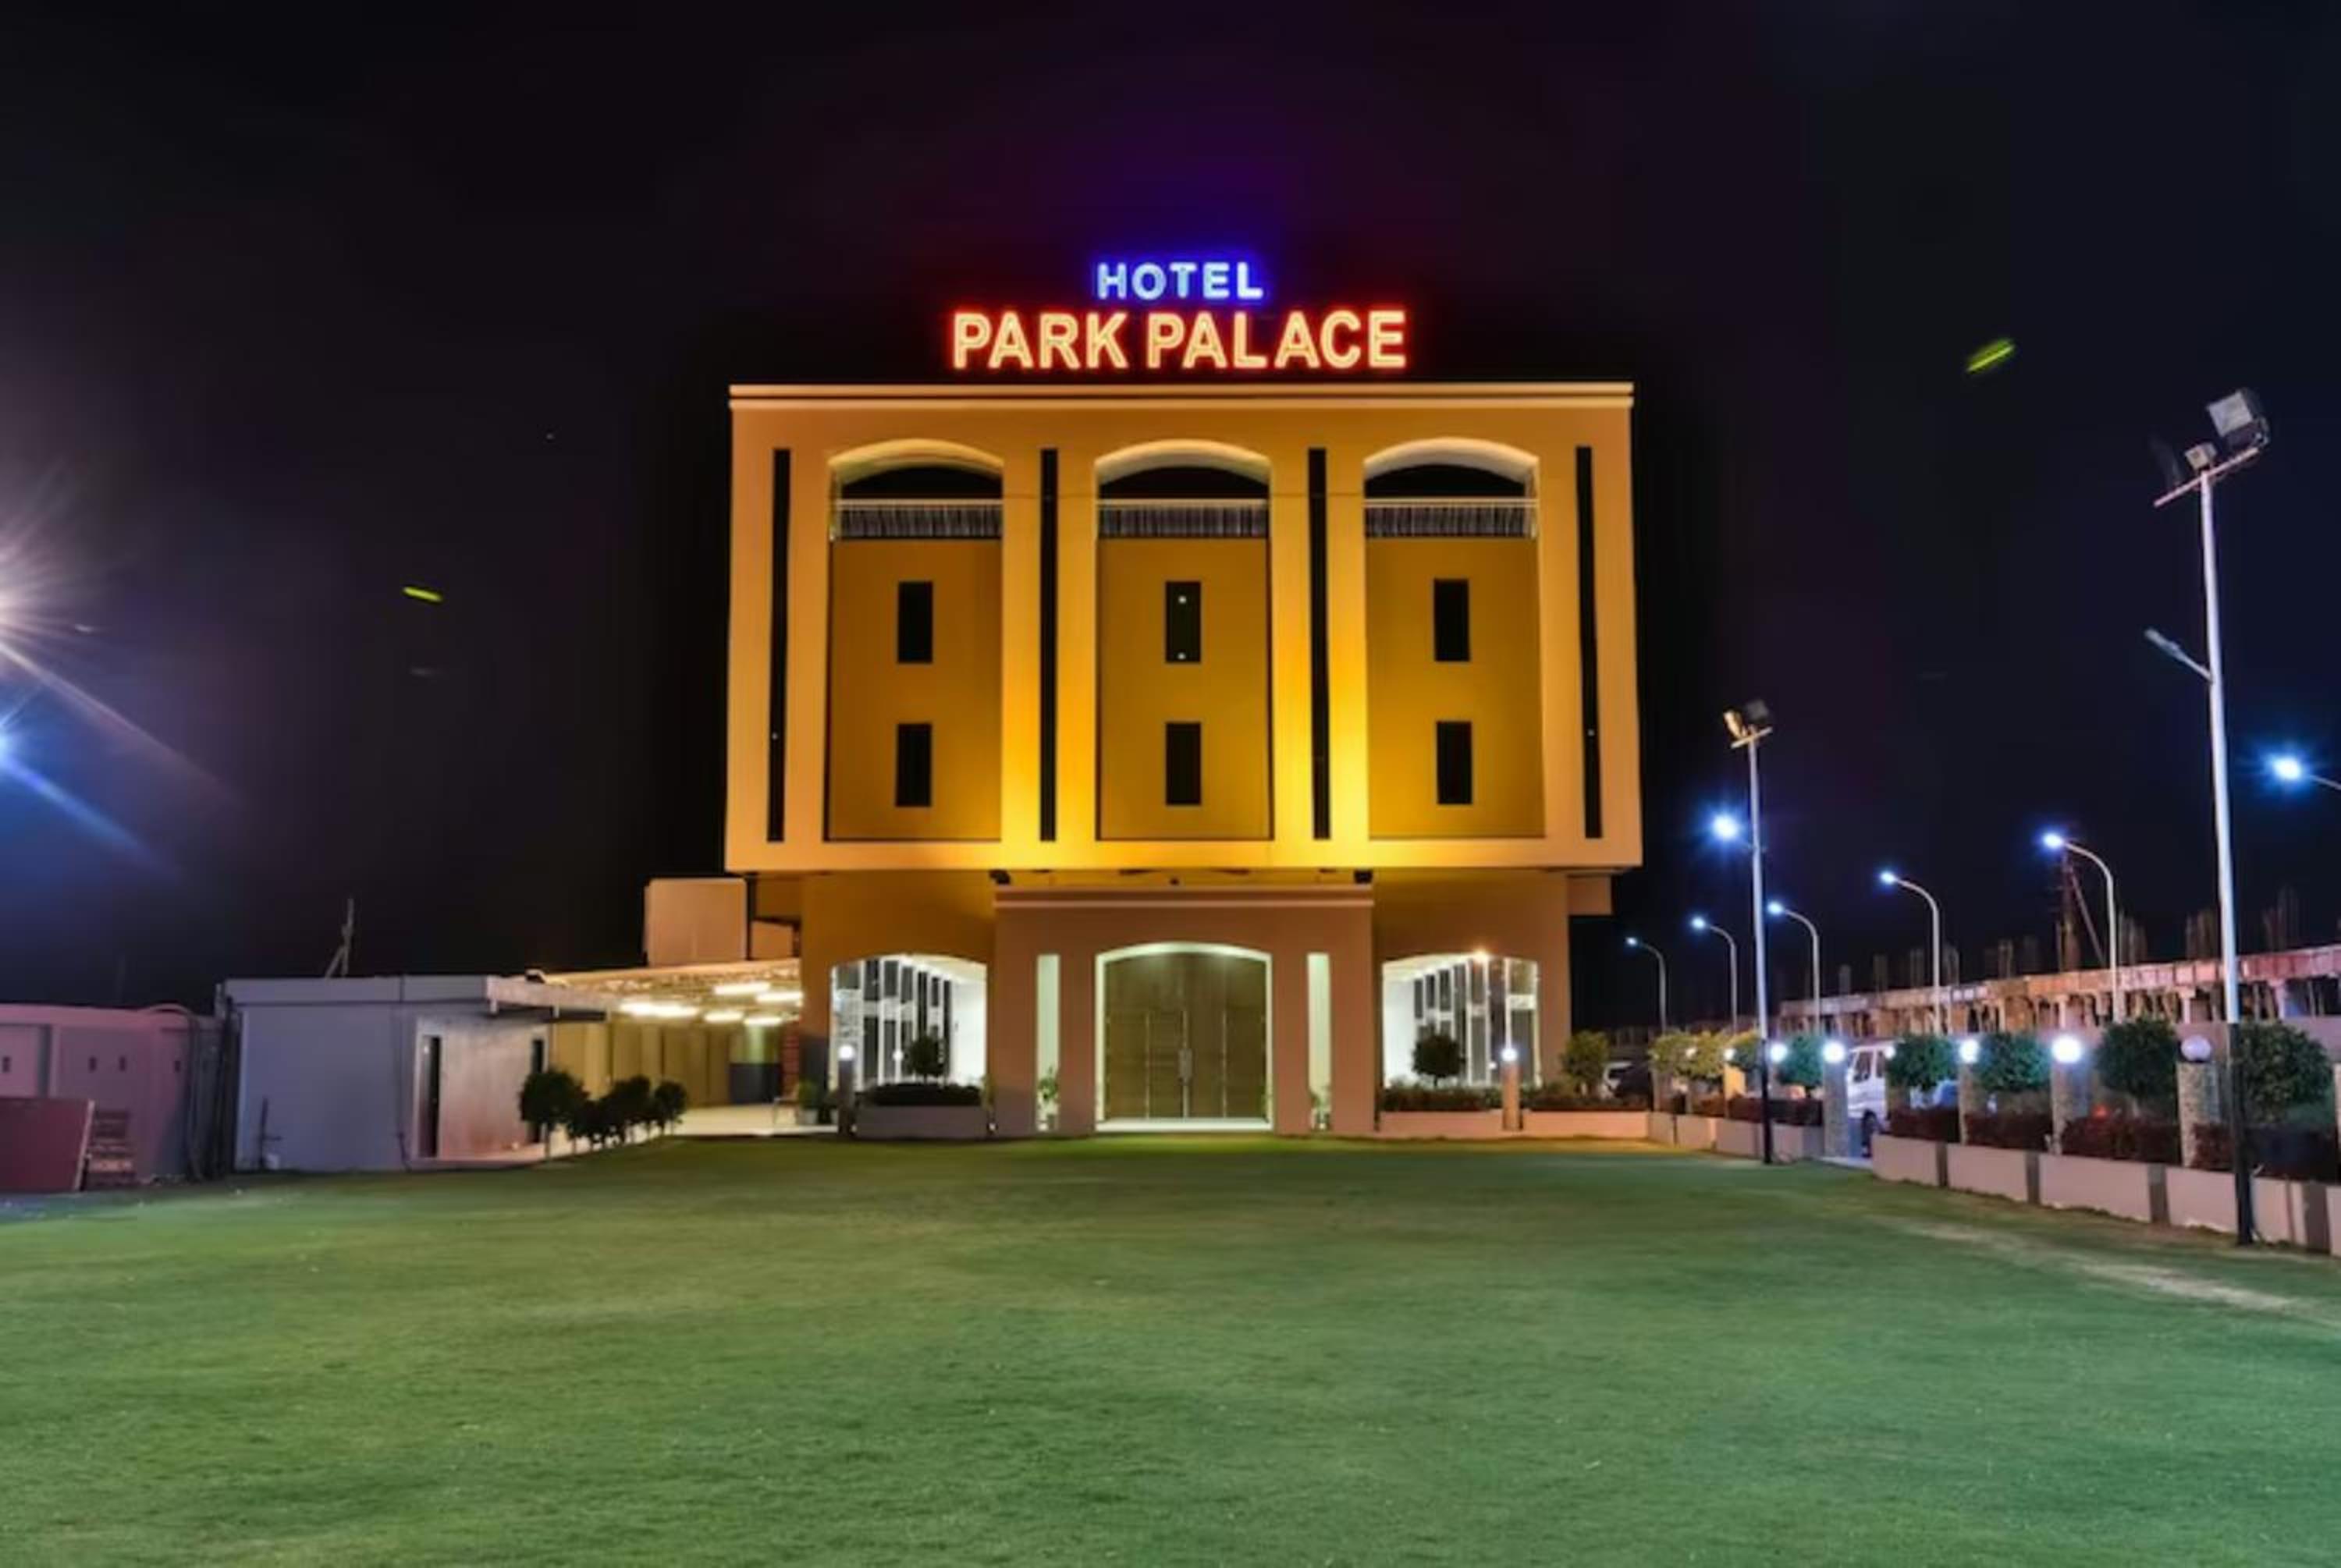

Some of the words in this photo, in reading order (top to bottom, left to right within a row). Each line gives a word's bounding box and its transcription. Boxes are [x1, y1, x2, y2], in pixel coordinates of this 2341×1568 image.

[1097, 261, 1263, 300] HOTEL
[953, 310, 1128, 369] PARK
[1146, 310, 1406, 369] PALACE
